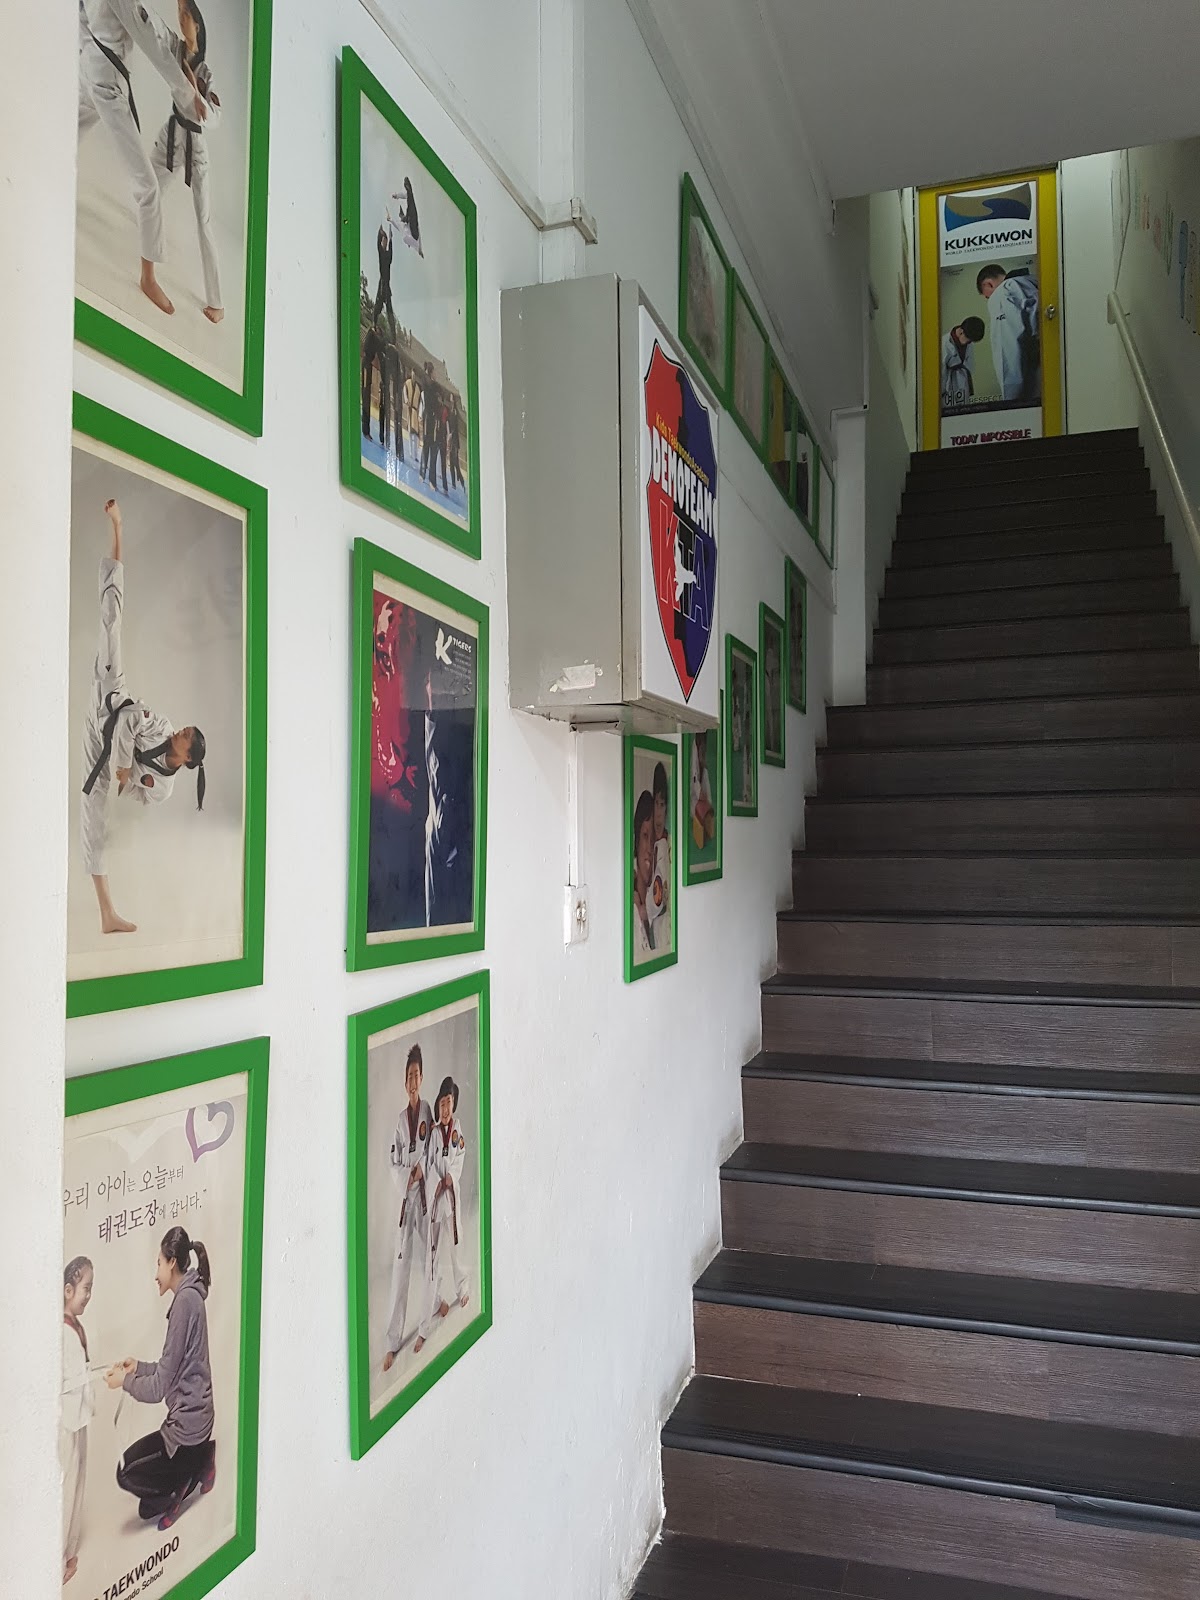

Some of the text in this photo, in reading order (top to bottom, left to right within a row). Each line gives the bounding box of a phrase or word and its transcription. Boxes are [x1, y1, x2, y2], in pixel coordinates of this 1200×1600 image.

[945, 229, 1032, 251] KUKKIWON
[964, 245, 994, 253] TAEKWONDO
[950, 429, 1031, 446] TODAY IMPOSSIBLE
[652, 425, 713, 538] DEMOTEAM
[435, 628, 472, 665] K TIGERS
[64, 1165, 184, 1217] 우리 아이는 오늘부터
[98, 1199, 166, 1243] 태권도장에
[102, 1536, 180, 1600] TAEKWONDO
[142, 1567, 164, 1590] School
